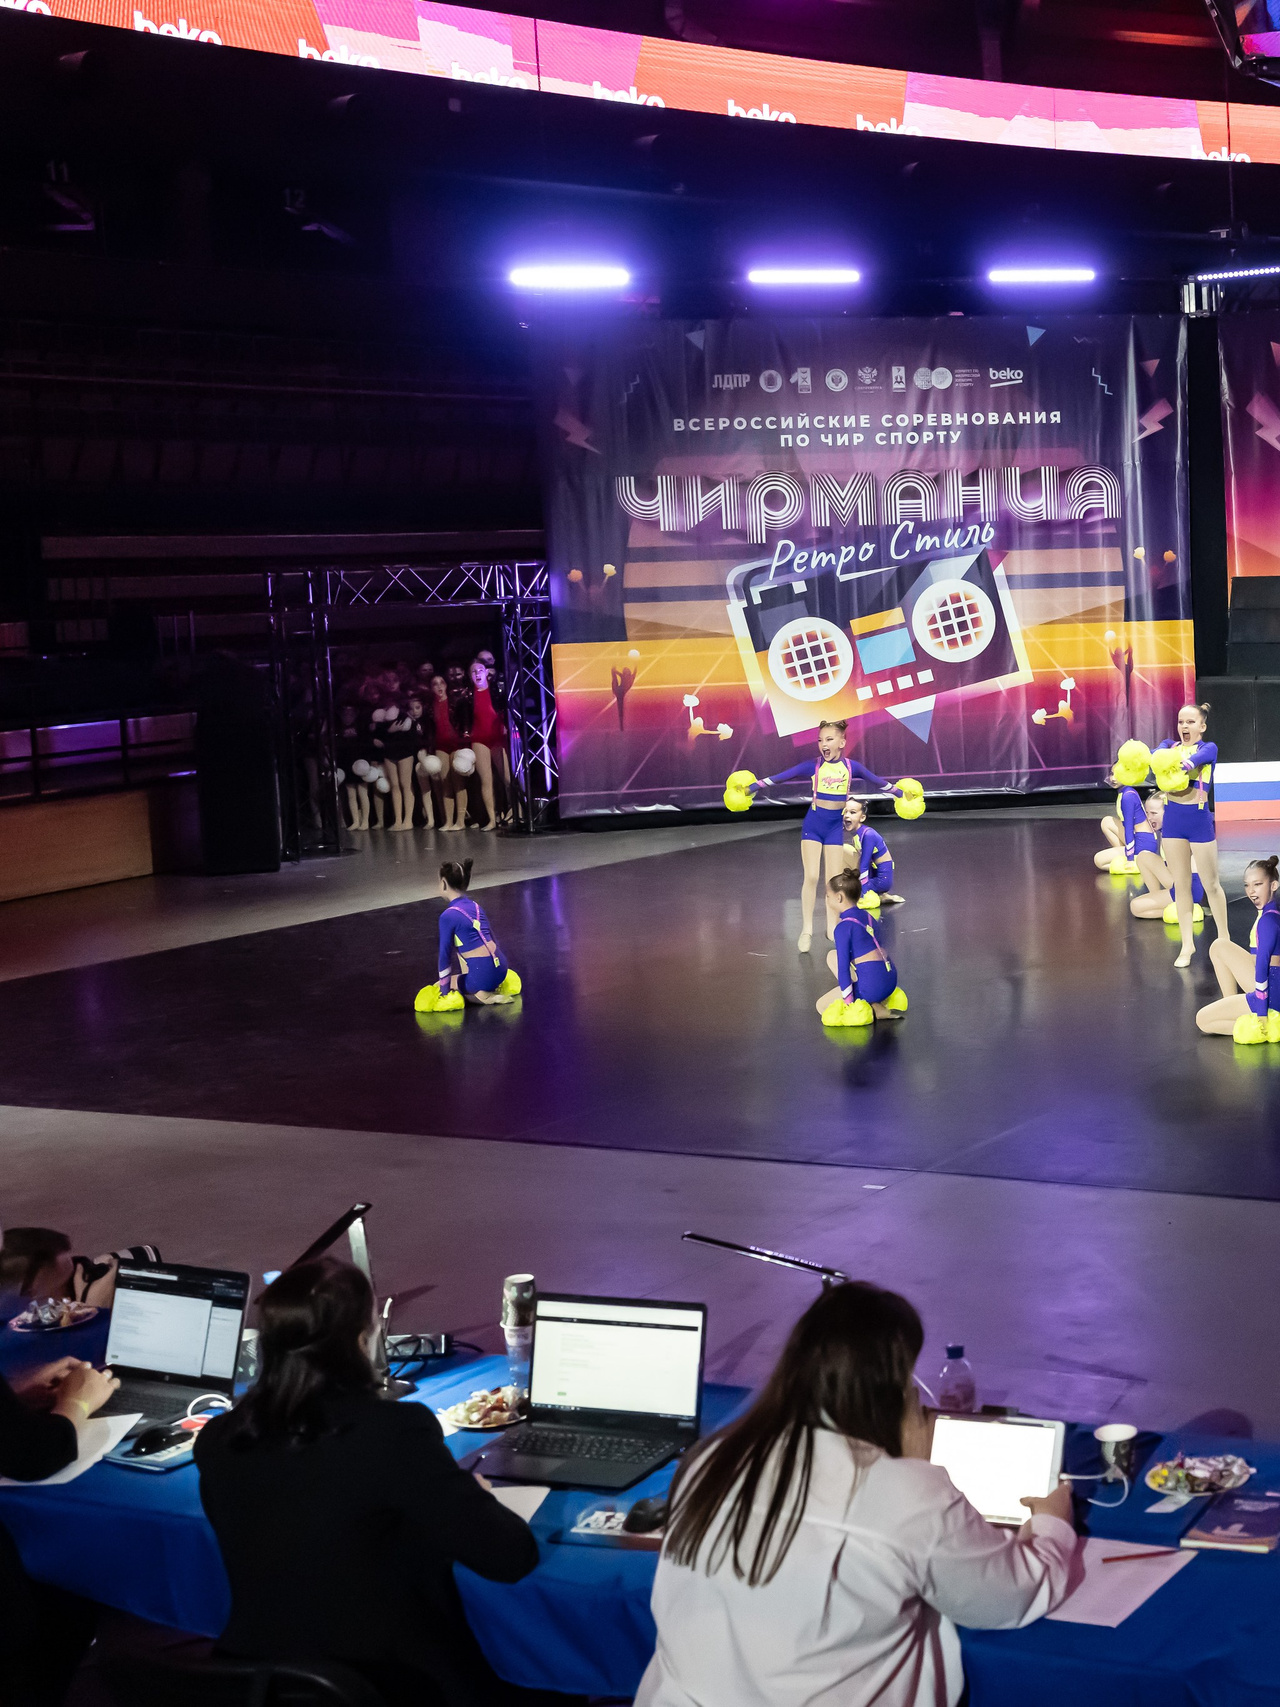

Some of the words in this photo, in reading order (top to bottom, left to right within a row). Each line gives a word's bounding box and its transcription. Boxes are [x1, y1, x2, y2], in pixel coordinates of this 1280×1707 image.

[712, 373, 751, 390] ЛДПР
[989, 367, 1024, 380] beko
[673, 412, 871, 431] ВСЕРОССИЙСКИЕ
[881, 410, 1062, 428] СОРЕВНОВАНИЯ
[780, 433, 810, 447] ПО
[820, 433, 865, 446] ЧИР
[875, 430, 962, 446] СПОРТУ
[768, 538, 876, 581] Ретро
[889, 520, 996, 561] Стиль
